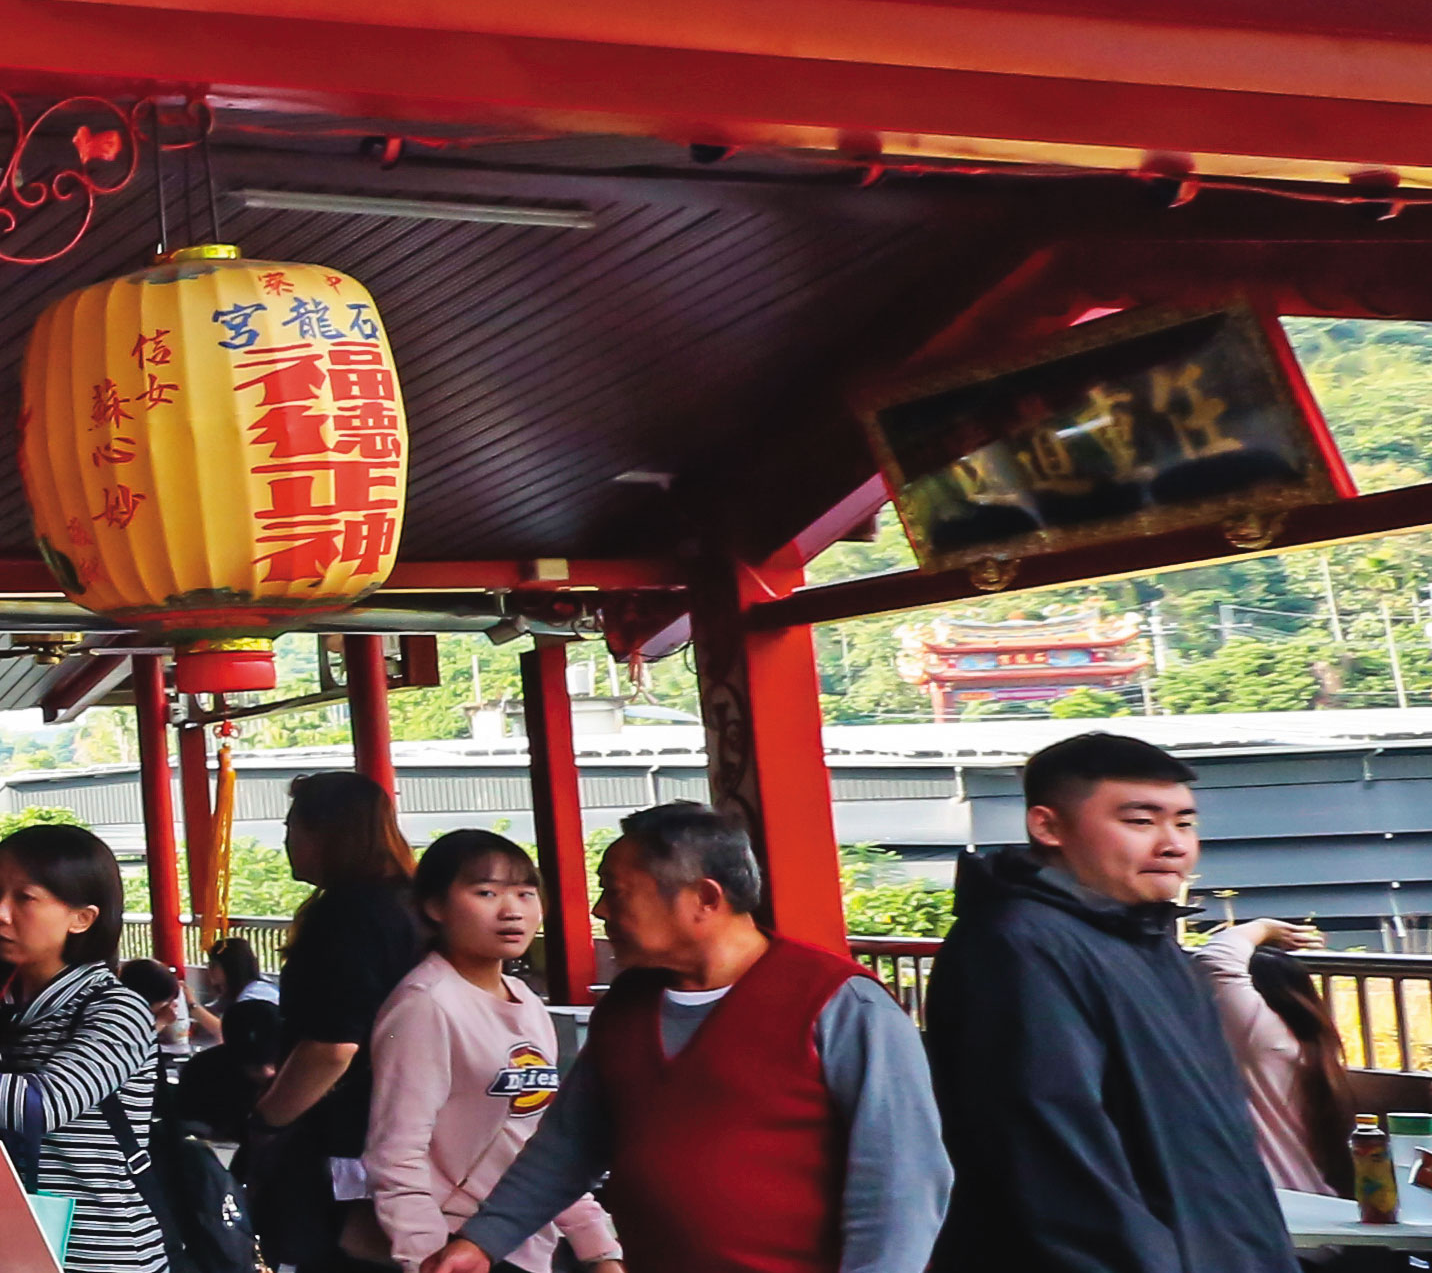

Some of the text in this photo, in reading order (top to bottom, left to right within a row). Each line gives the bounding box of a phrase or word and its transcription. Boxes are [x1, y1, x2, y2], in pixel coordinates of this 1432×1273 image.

[212, 297, 380, 349] 石龍宮
[131, 328, 180, 411] 信女
[233, 341, 401, 583] 福德正神
